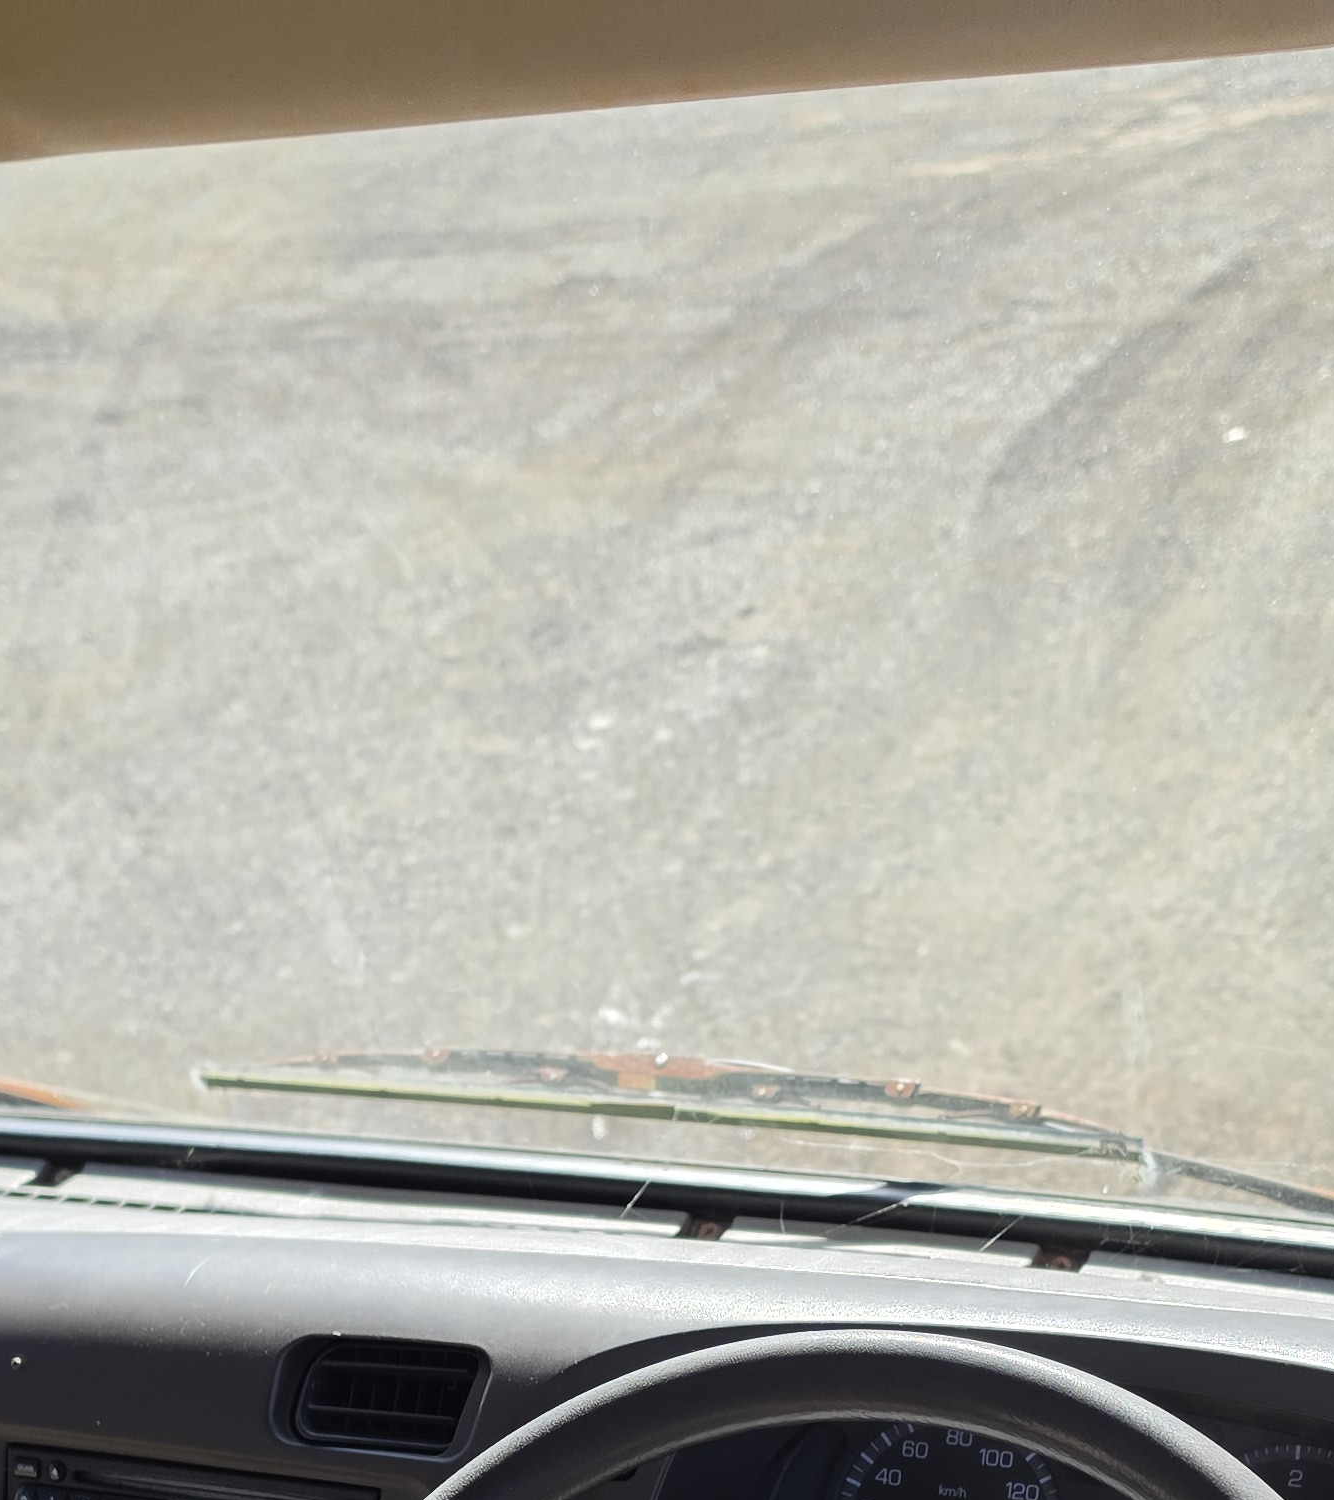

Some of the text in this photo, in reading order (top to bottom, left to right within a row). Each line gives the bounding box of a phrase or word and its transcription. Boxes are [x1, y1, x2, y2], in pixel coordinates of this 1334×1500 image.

[945, 1429, 973, 1447] 80
[902, 1440, 928, 1459] 60
[979, 1448, 1014, 1468] 100
[875, 1467, 902, 1487] 40
[1287, 1469, 1304, 1489] 2
[938, 1484, 967, 1498] km/h
